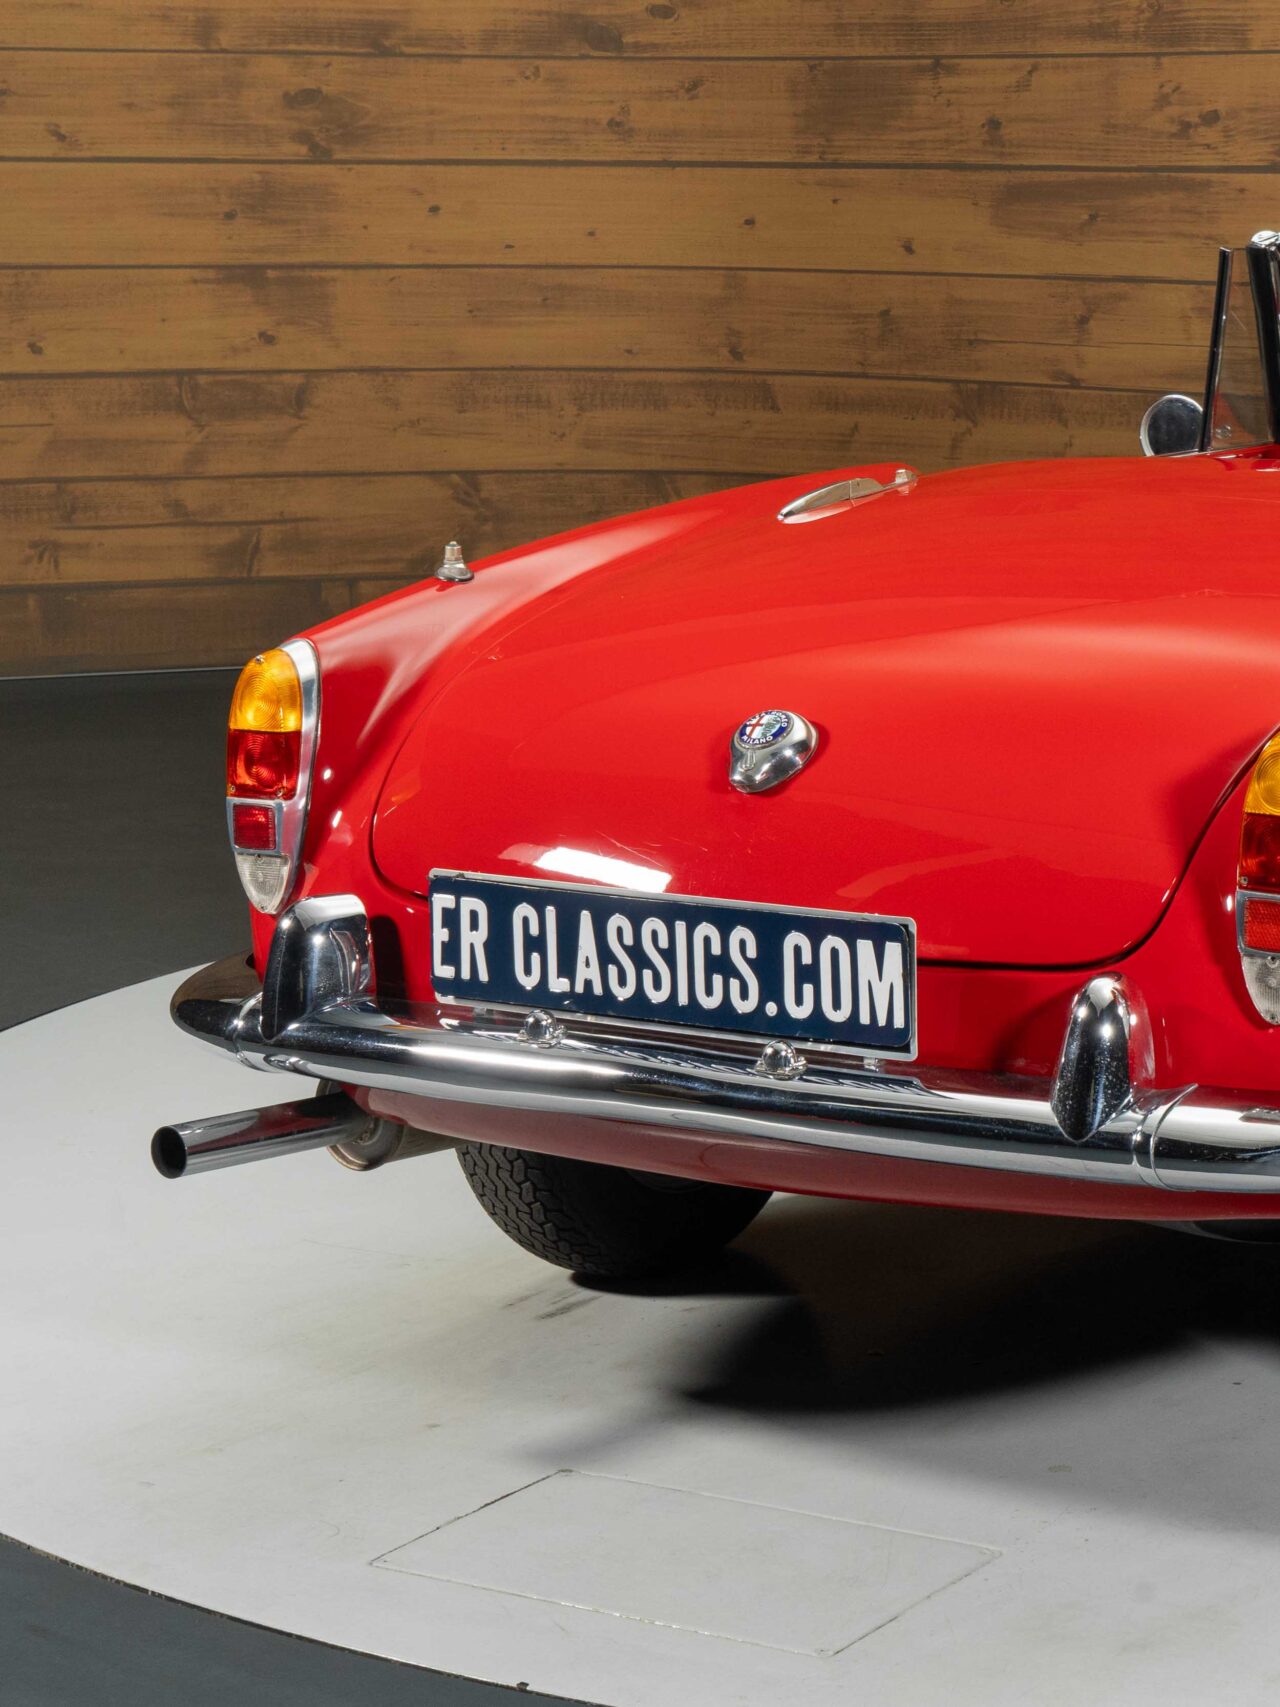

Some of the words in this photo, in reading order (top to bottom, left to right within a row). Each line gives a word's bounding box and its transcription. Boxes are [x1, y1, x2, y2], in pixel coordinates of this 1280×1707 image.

[741, 735, 773, 744] MILANO
[431, 892, 489, 983] ER
[512, 902, 906, 1029] CLASSICS.COM
